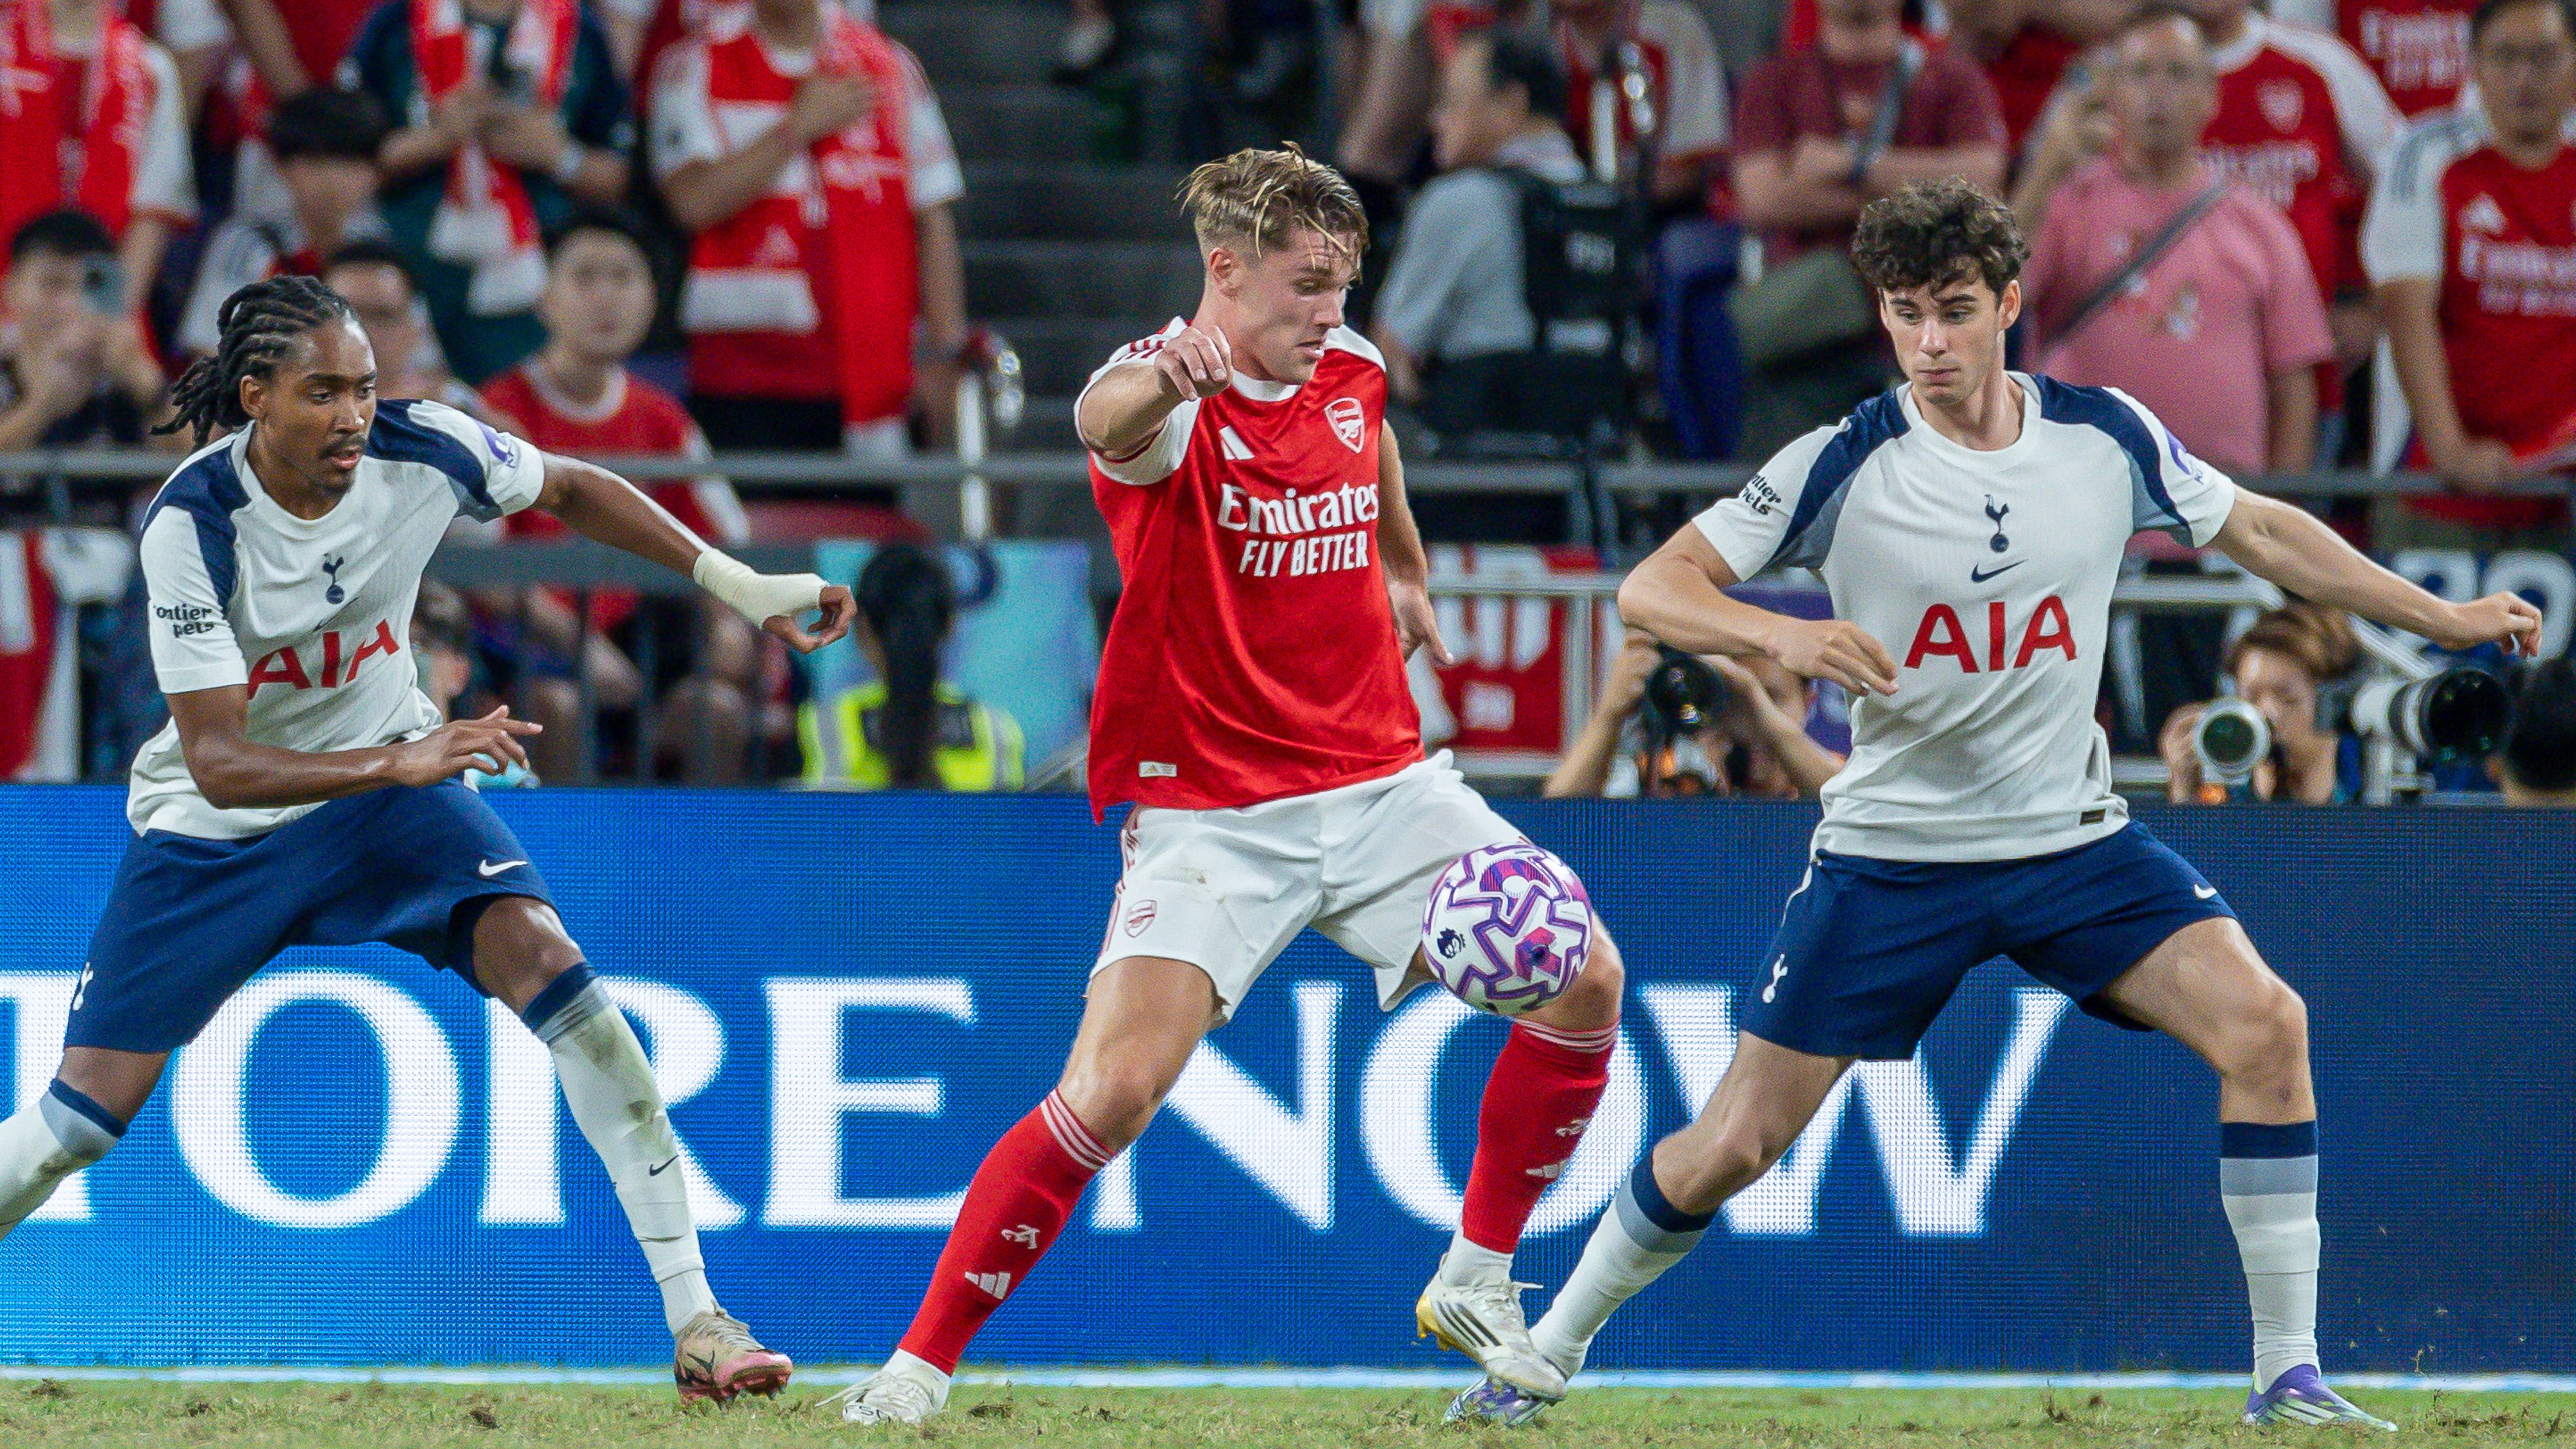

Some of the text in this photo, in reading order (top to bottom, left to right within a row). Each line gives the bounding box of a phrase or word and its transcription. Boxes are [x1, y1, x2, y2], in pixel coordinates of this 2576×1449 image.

[1218, 481, 1379, 535] Emirates
[1238, 531, 1369, 577] FLY BETTER
[153, 603, 212, 620] ontier
[1904, 594, 2077, 673] AIA
[247, 618, 400, 700] AIA
[1090, 978, 2071, 1239] NOW
